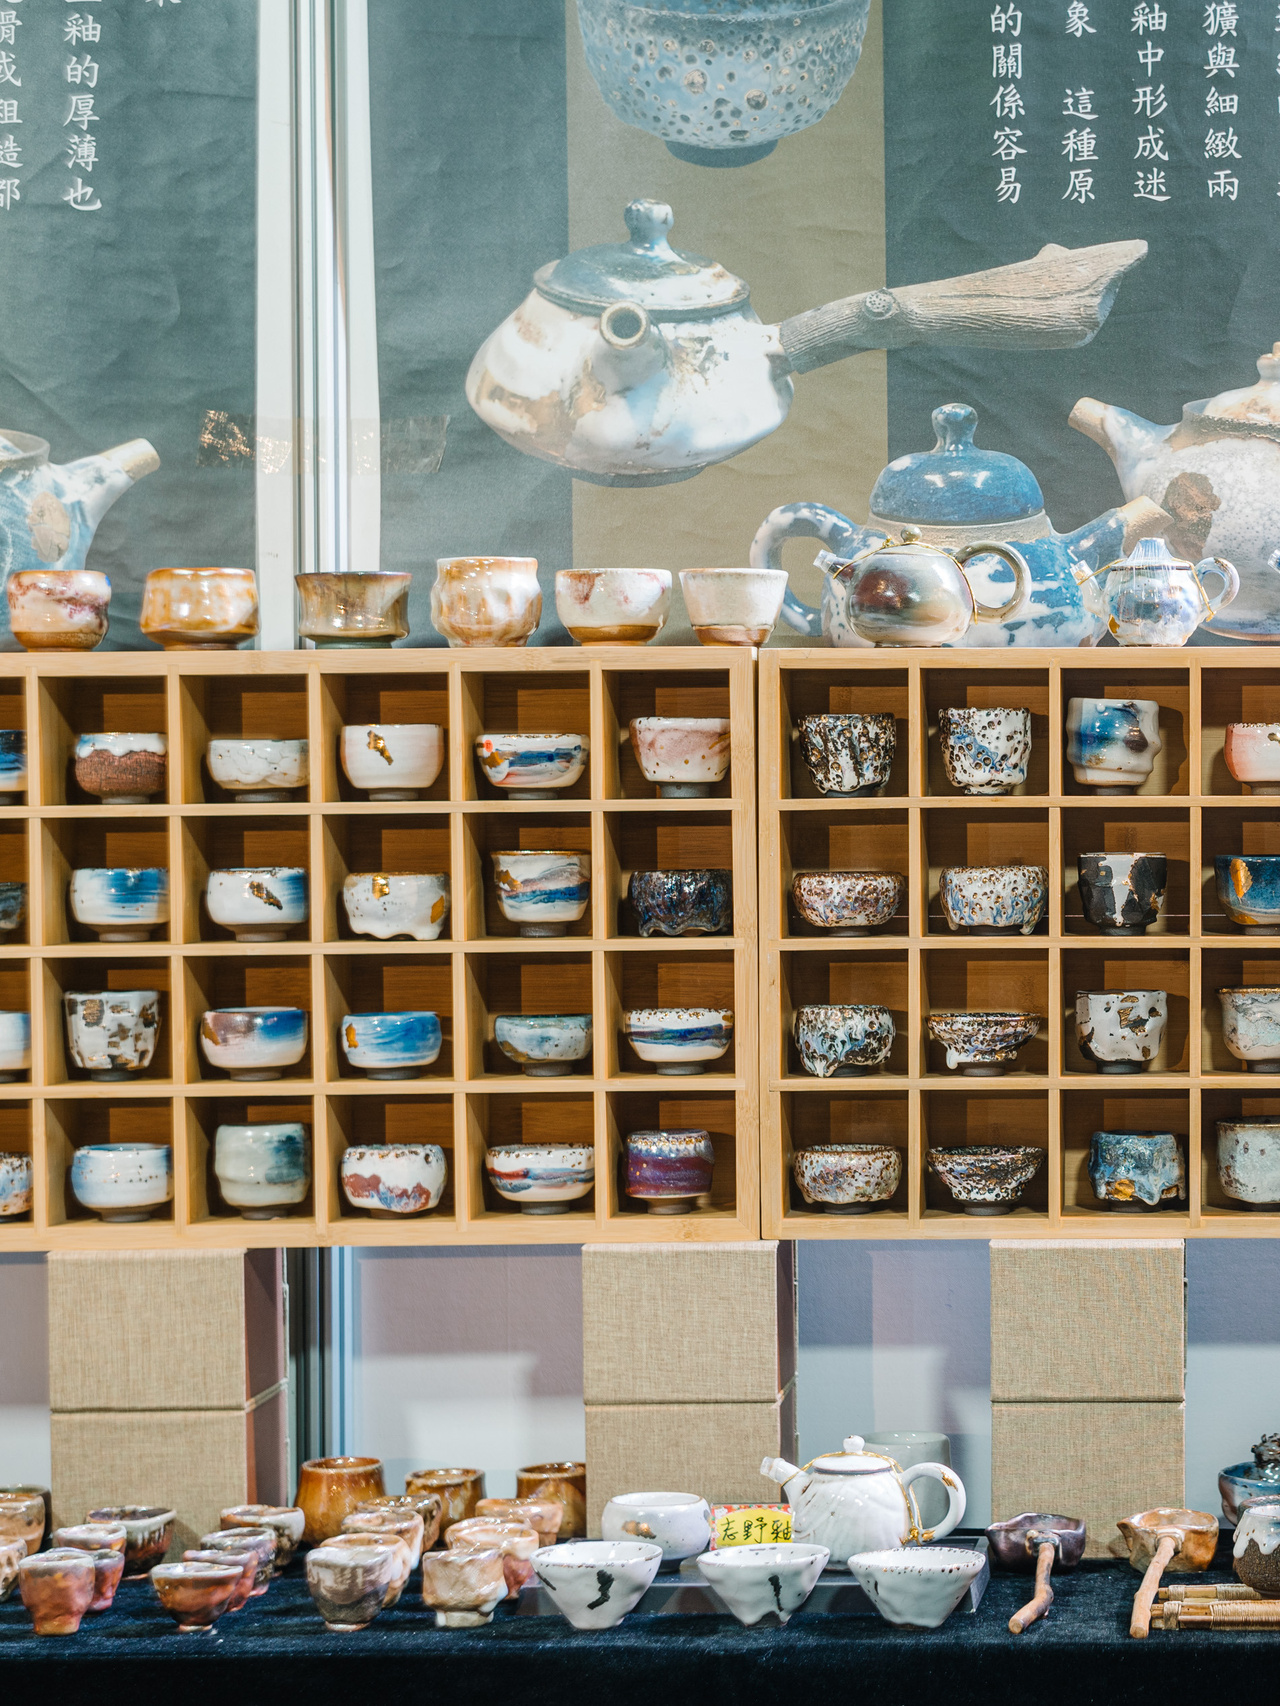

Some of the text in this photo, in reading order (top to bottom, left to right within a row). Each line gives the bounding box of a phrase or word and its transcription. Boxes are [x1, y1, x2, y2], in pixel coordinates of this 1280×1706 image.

[63, 0, 102, 211] 釉的厚薄也
[990, 2, 1028, 204] 的關係容易
[1061, 0, 1099, 204] 象 這種原
[1131, 1, 1172, 202] 釉中形成迷
[1202, 1, 1243, 201] 獷與細緻兩
